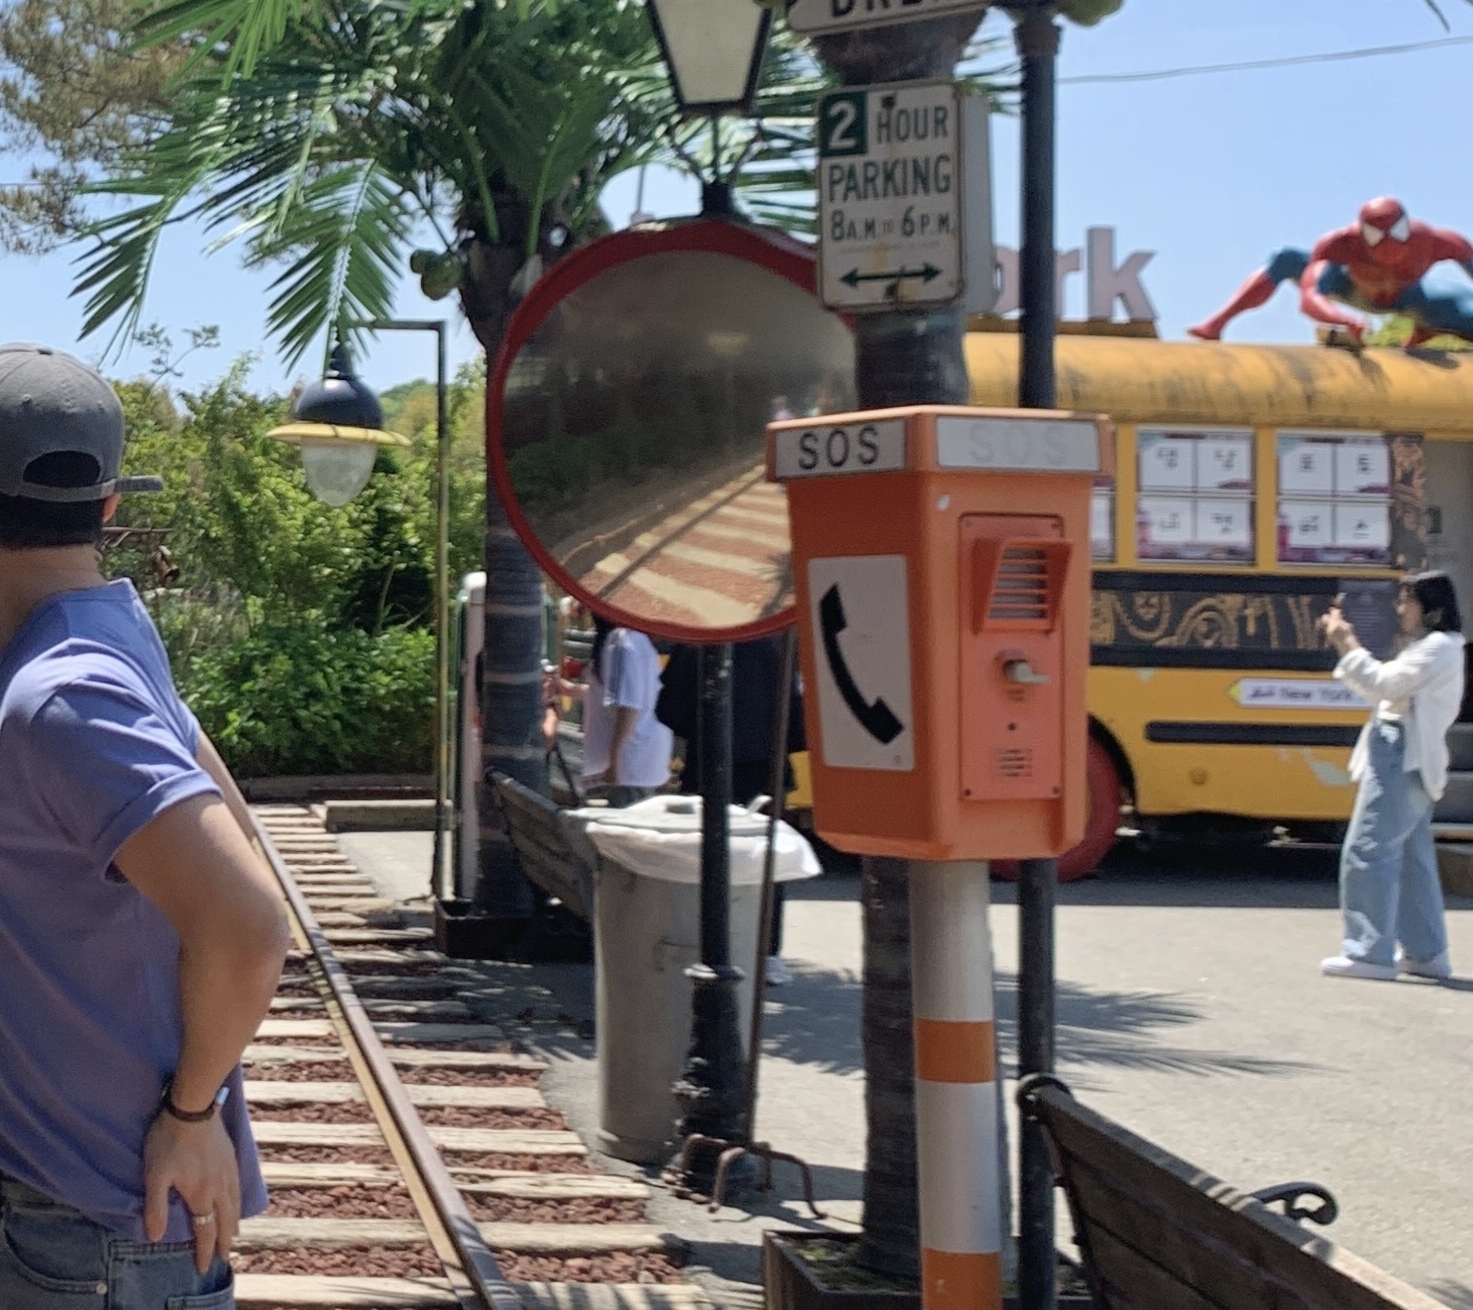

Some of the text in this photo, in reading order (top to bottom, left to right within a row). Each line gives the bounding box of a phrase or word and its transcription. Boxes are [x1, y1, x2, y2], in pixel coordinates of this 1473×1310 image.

[829, 100, 949, 149] 2 HOUR
[828, 153, 952, 204] PARKING
[797, 425, 880, 471] SOS
[968, 421, 1066, 466] SOS
